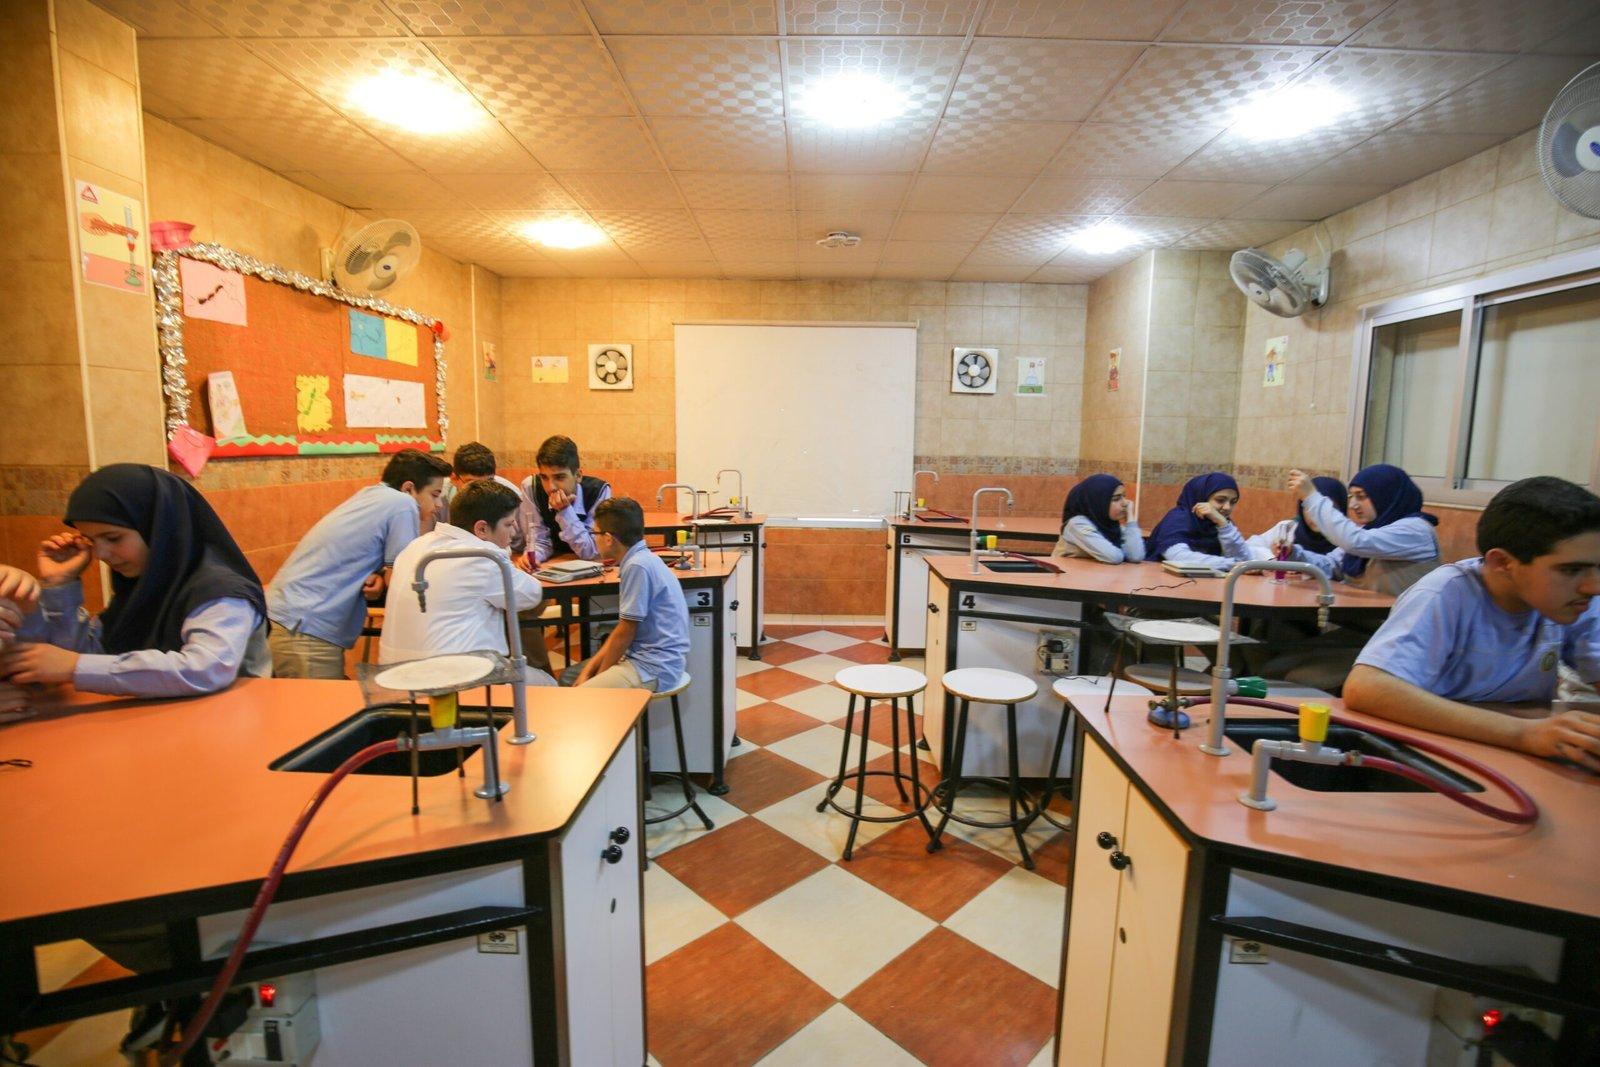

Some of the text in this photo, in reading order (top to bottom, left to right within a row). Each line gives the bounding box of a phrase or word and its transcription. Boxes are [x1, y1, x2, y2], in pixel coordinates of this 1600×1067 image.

[743, 533, 751, 542] 5
[903, 535, 911, 544] 6
[697, 592, 710, 606] 3
[962, 595, 976, 609] 4
